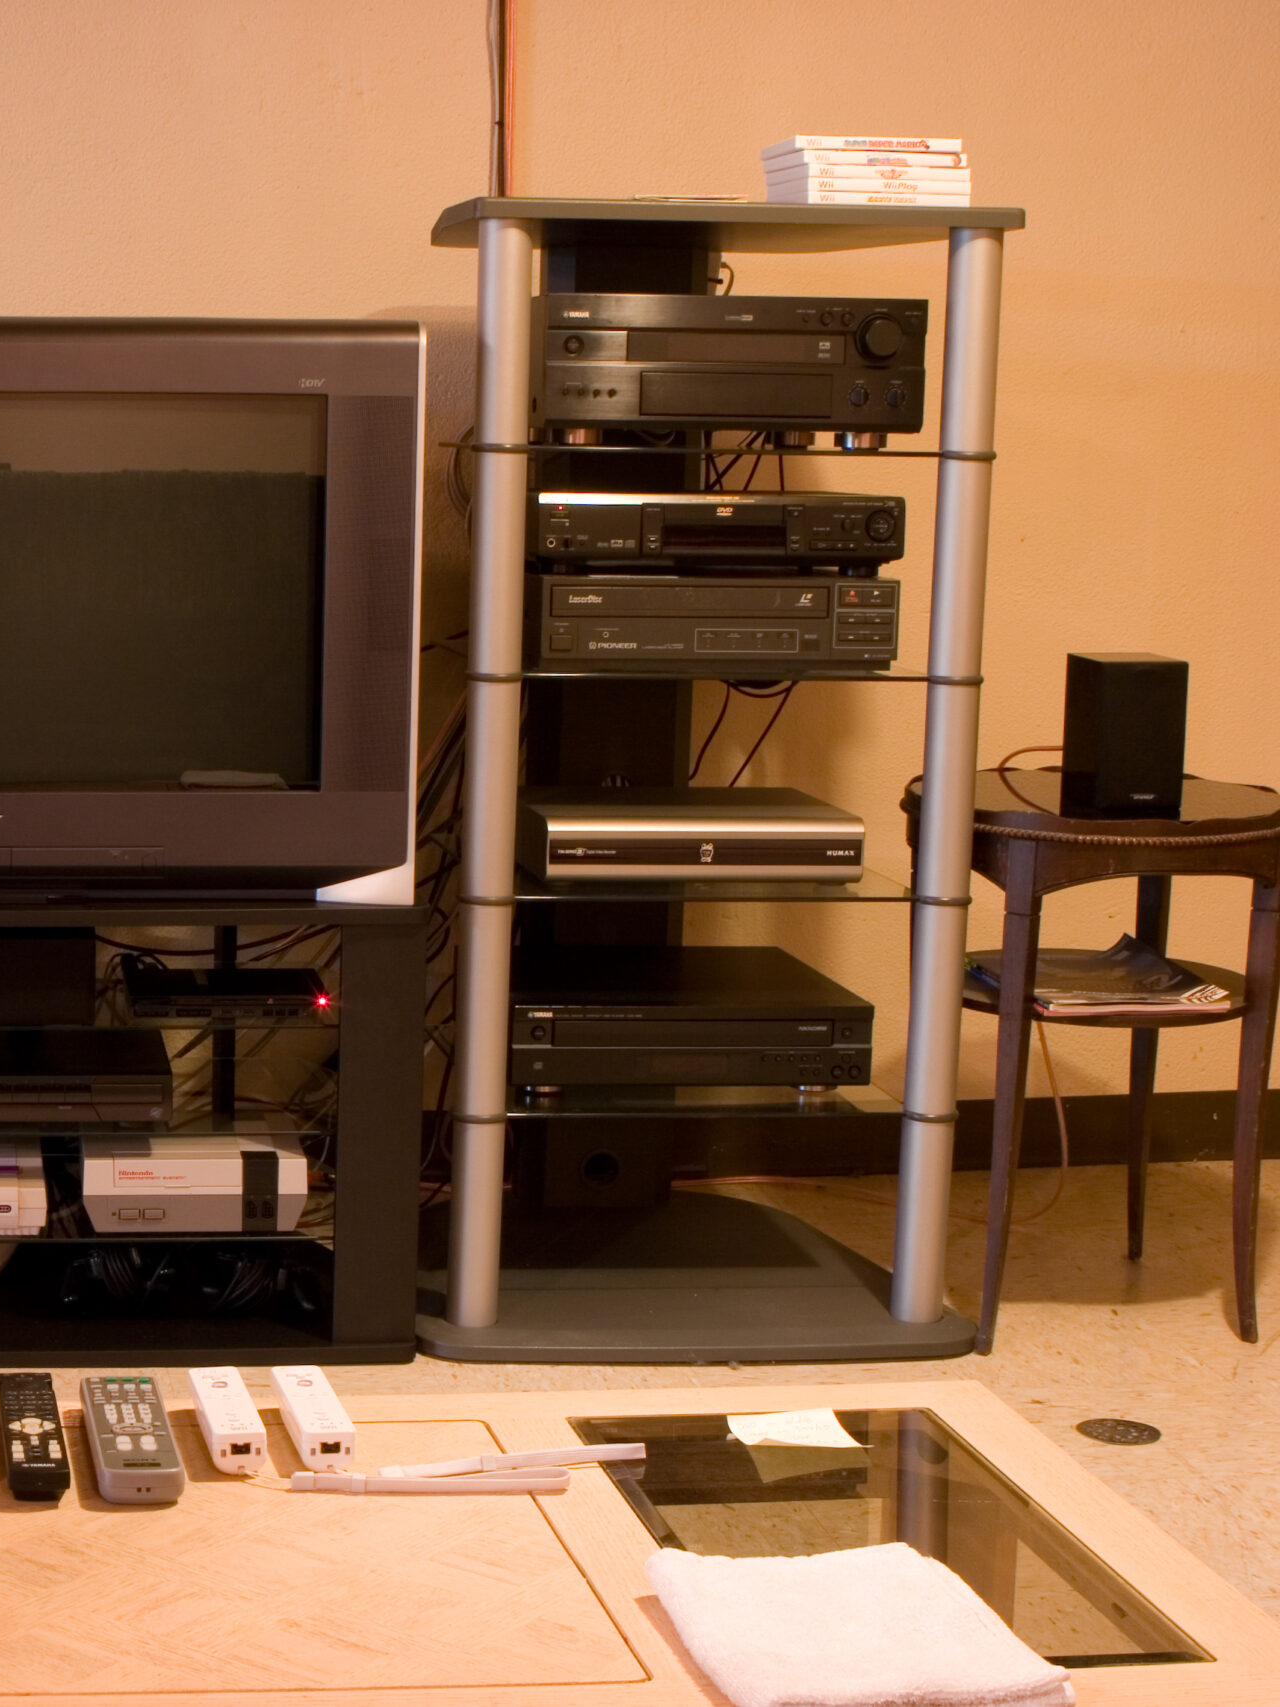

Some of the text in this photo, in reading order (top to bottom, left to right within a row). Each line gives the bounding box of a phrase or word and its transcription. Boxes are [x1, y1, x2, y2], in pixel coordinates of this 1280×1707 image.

[814, 153, 830, 162] Wii
[819, 168, 834, 176] Wii
[818, 180, 834, 189] Wii
[819, 193, 835, 202] Wii
